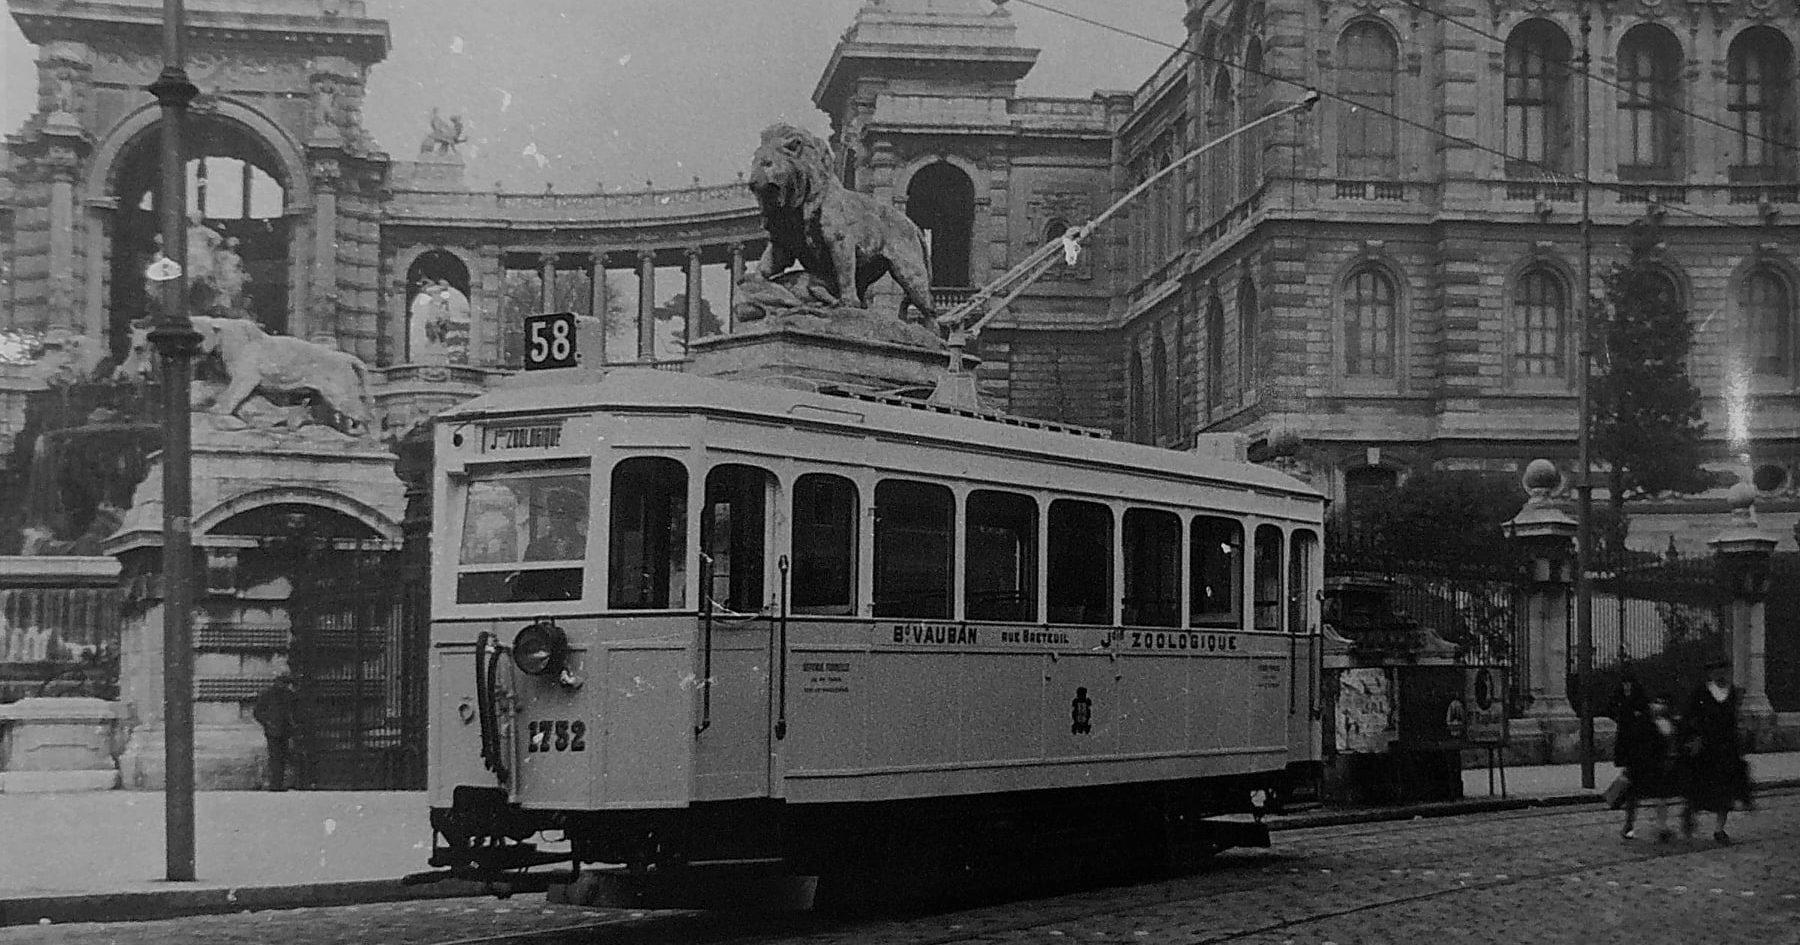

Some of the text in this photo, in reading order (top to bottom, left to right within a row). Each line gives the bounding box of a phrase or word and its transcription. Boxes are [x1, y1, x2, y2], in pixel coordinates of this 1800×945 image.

[530, 319, 571, 363] 58
[913, 625, 978, 645] VAUBAN
[1132, 632, 1237, 652] ZOOLOGIQUE
[528, 720, 587, 753] 1752
